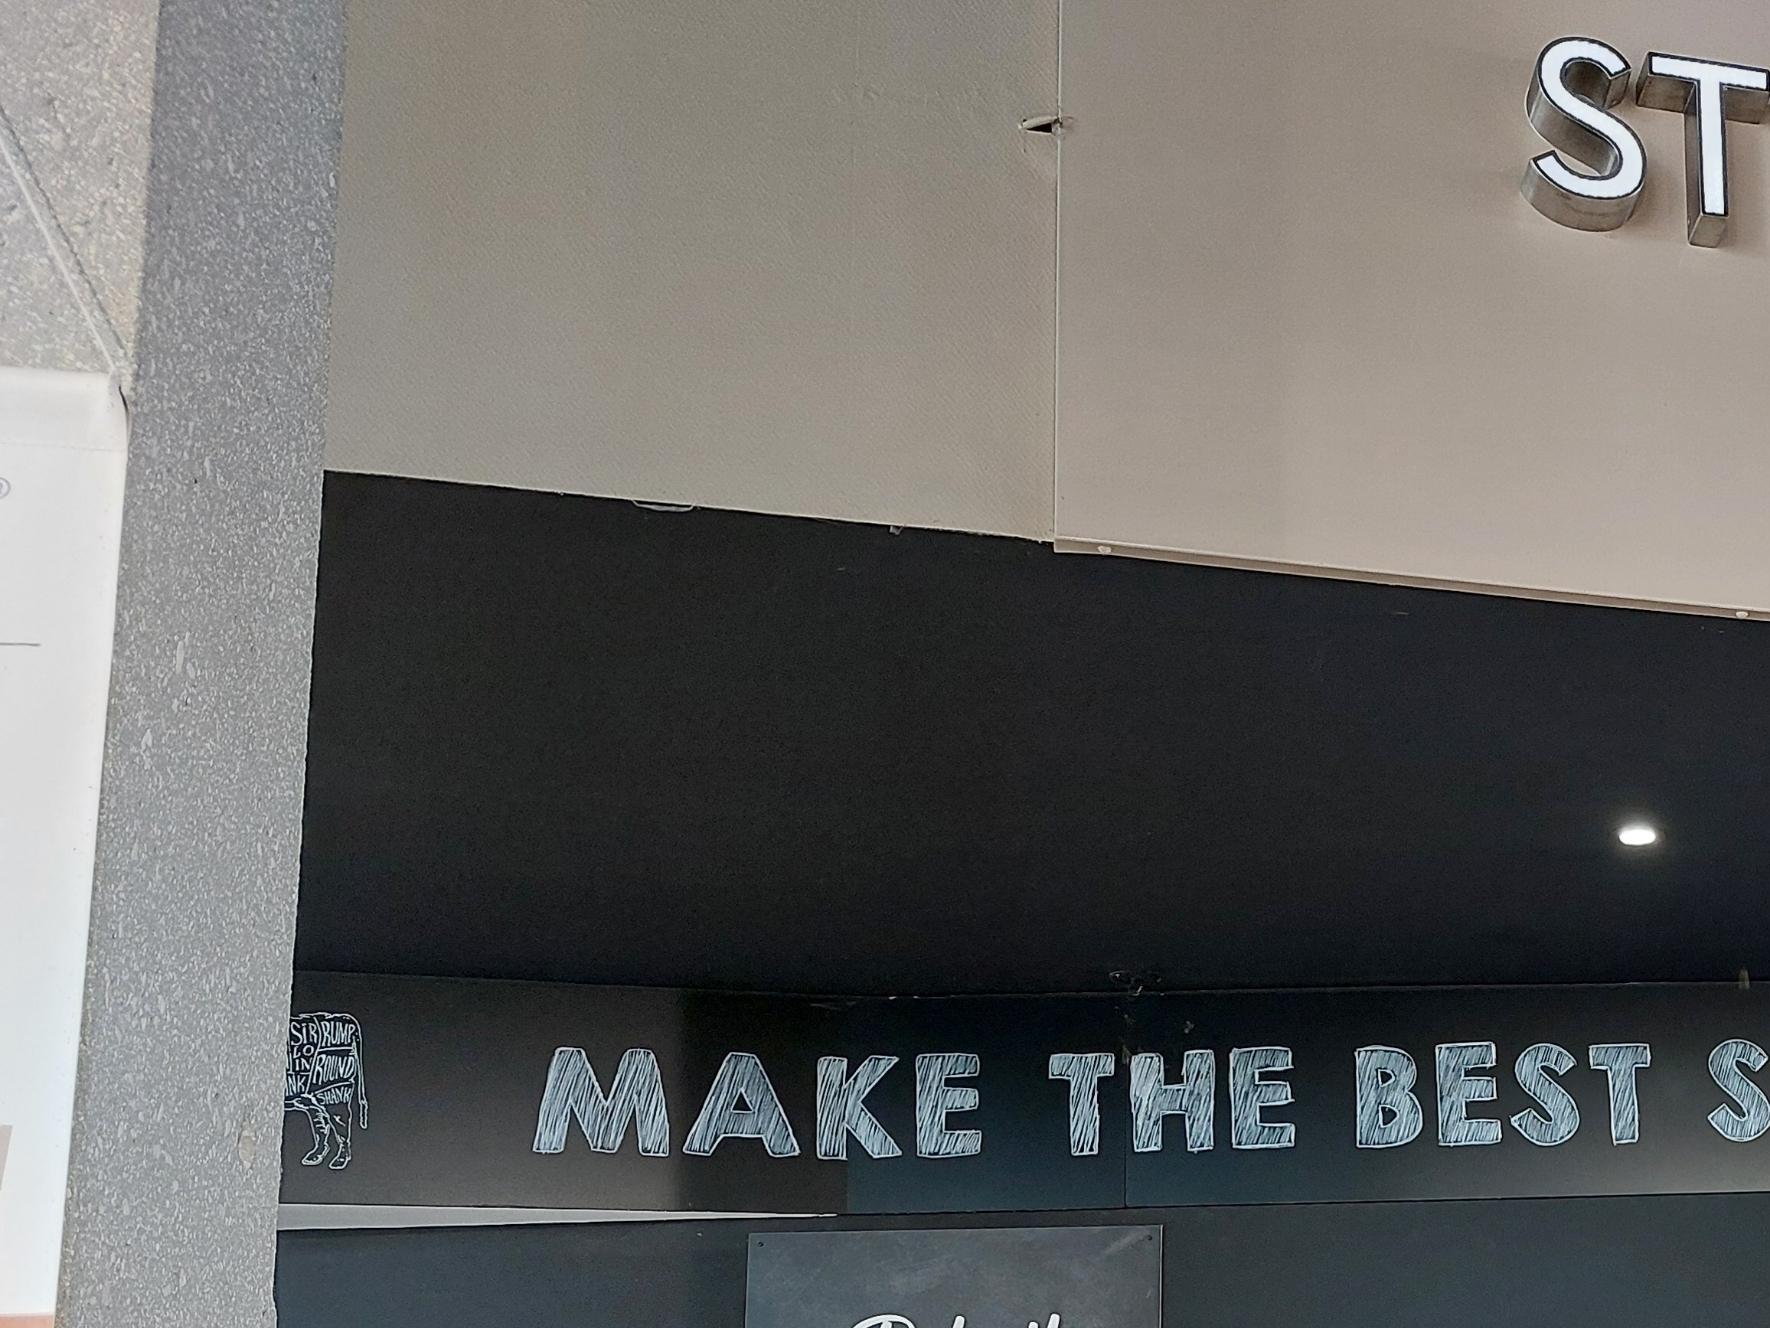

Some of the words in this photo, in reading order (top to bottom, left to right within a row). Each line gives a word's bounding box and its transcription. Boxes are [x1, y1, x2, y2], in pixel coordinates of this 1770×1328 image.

[320, 1021, 356, 1047] RUMP
[313, 1053, 355, 1086] ROUND
[316, 1086, 352, 1105] SHANK
[532, 1046, 983, 1160] MAKE
[1048, 1047, 1297, 1155] THE
[1355, 1038, 1652, 1149] BEST
